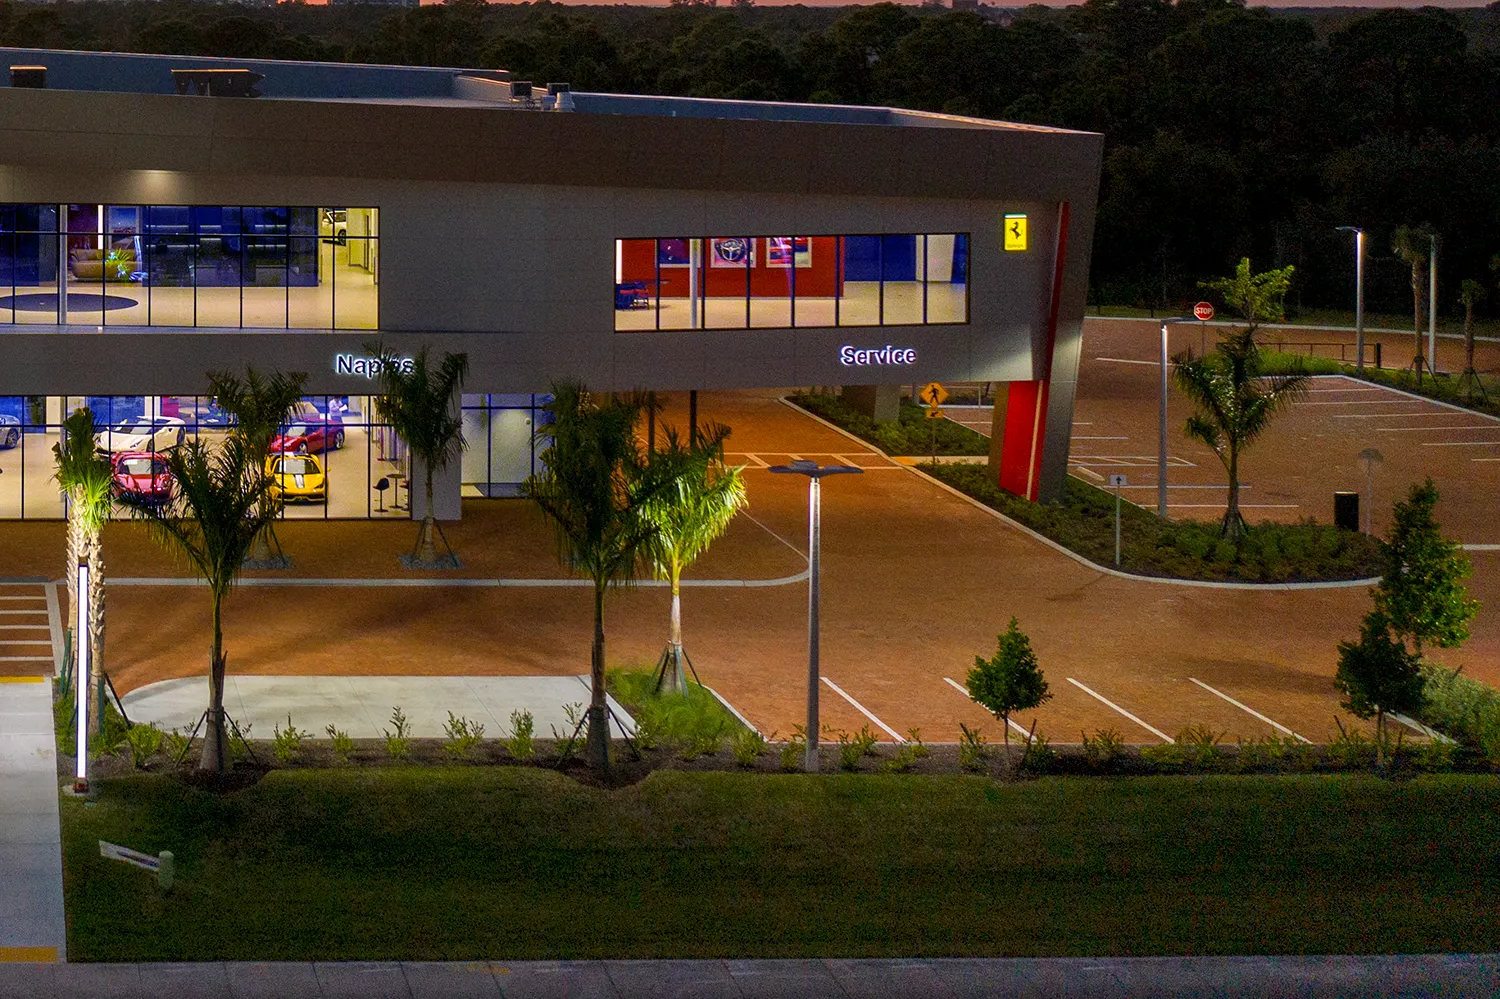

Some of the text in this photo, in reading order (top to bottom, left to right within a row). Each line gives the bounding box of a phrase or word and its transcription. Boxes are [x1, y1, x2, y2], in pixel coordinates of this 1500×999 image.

[1195, 307, 1211, 315] STOP
[840, 345, 916, 365] Service
[336, 354, 414, 379] Naps
